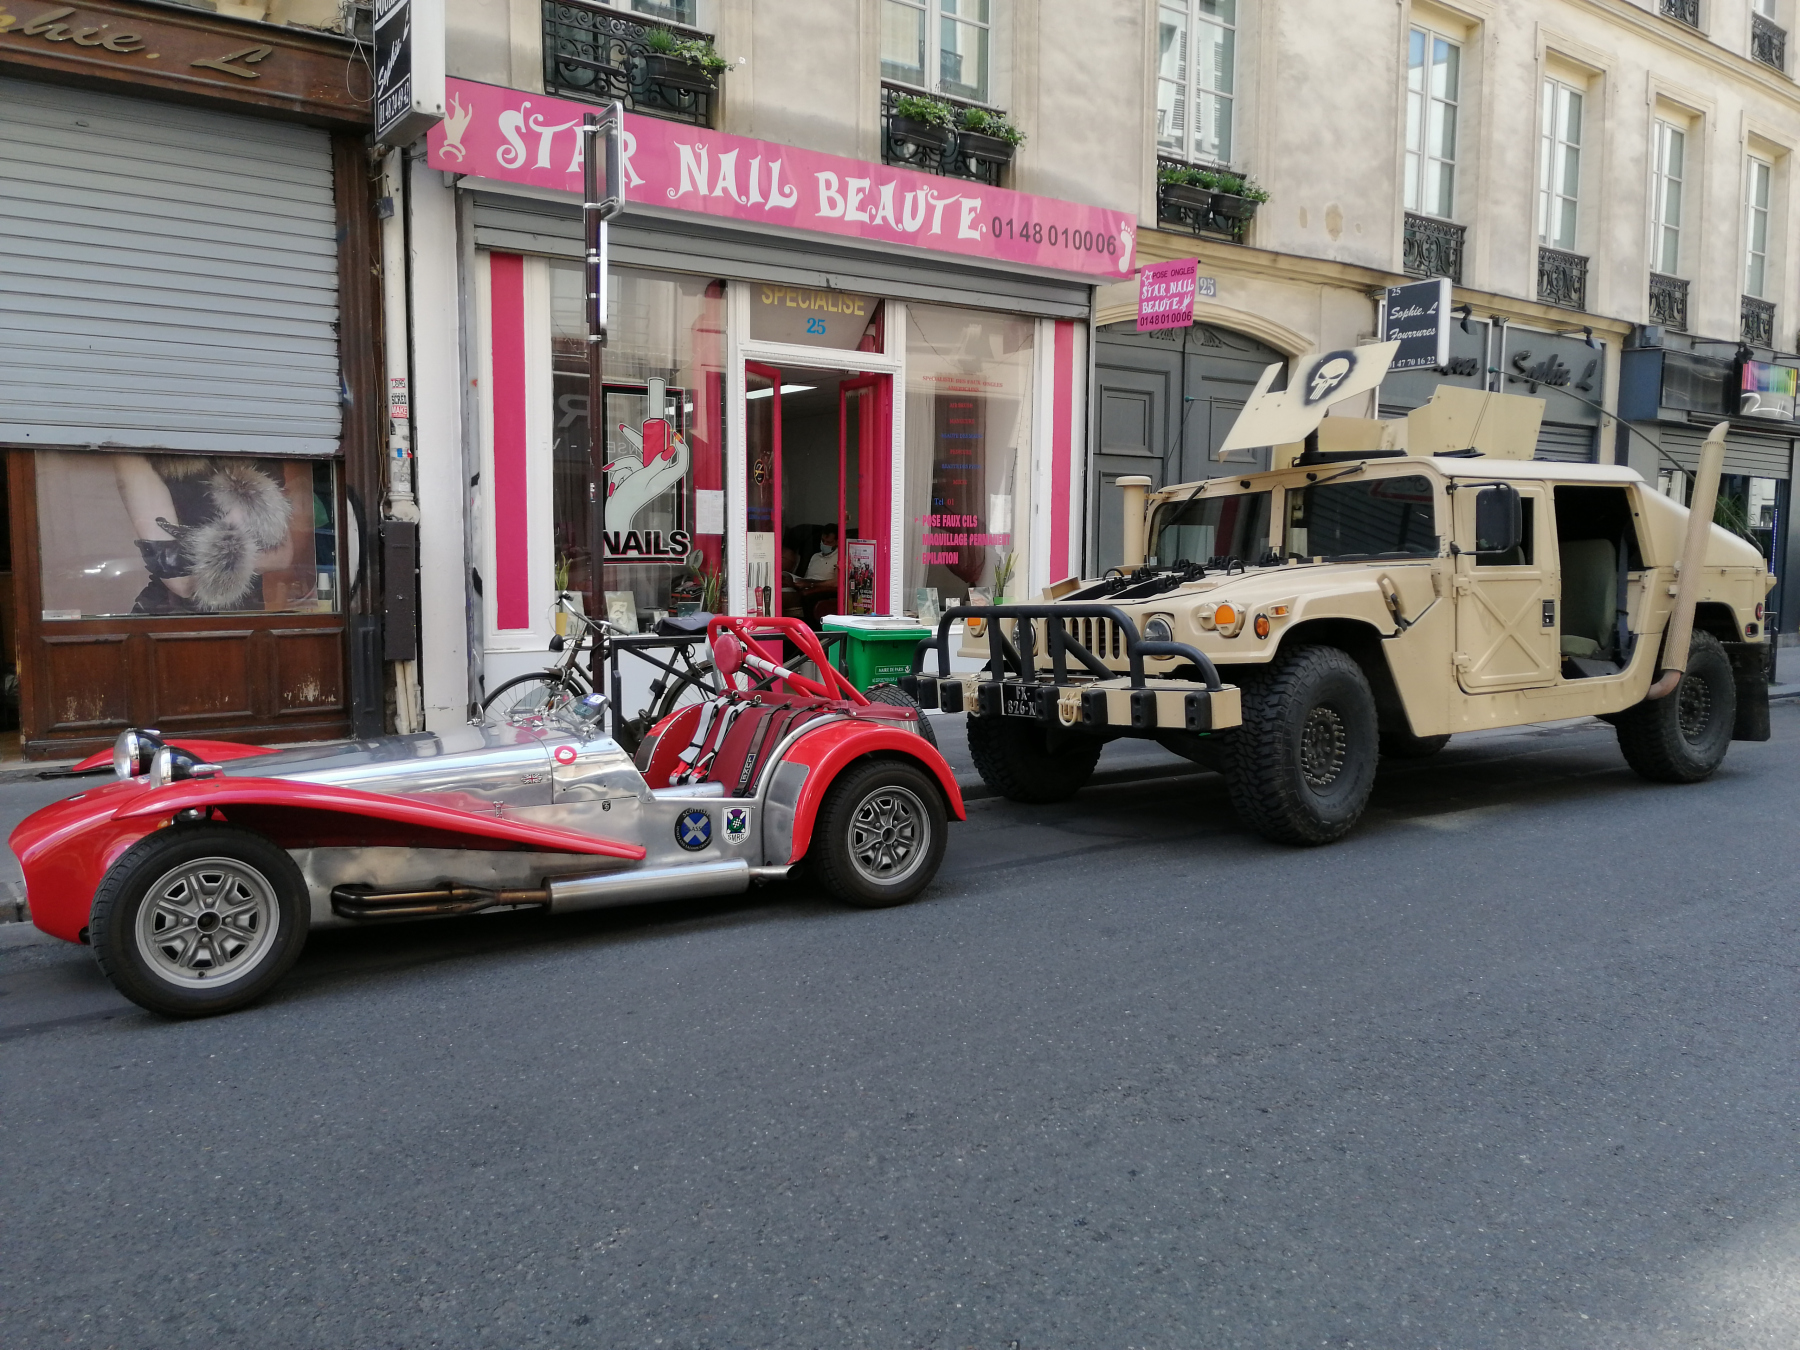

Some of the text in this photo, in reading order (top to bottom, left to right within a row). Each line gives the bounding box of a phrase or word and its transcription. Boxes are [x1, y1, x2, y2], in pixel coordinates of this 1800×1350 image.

[191, 45, 272, 78] L
[667, 141, 797, 211] NAIL
[814, 171, 986, 241] BEAUTE
[1153, 266, 1195, 279] POSE ONGLES
[1141, 279, 1194, 300] STAR NAIL
[1199, 278, 1215, 295] 25
[1391, 287, 1401, 297] 25
[1142, 297, 1180, 314] BEAUTE
[1427, 301, 1438, 314] L
[806, 317, 826, 335] 25
[1389, 327, 1436, 341] Fourrures
[1397, 359, 1405, 367] 47
[1407, 358, 1416, 366] 70
[1417, 357, 1425, 365] 16
[1427, 356, 1435, 364] 22
[934, 498, 954, 506] Tel 01
[922, 514, 978, 528] POSE FAUX CILS
[603, 530, 691, 557] NAILS
[922, 533, 1011, 546] MAQUILLAGE PERMANENT
[922, 552, 959, 565] EPILATION
[1016, 686, 1030, 700] FX-
[1007, 700, 1037, 715] 826-X
[727, 833, 745, 843] SMRC
